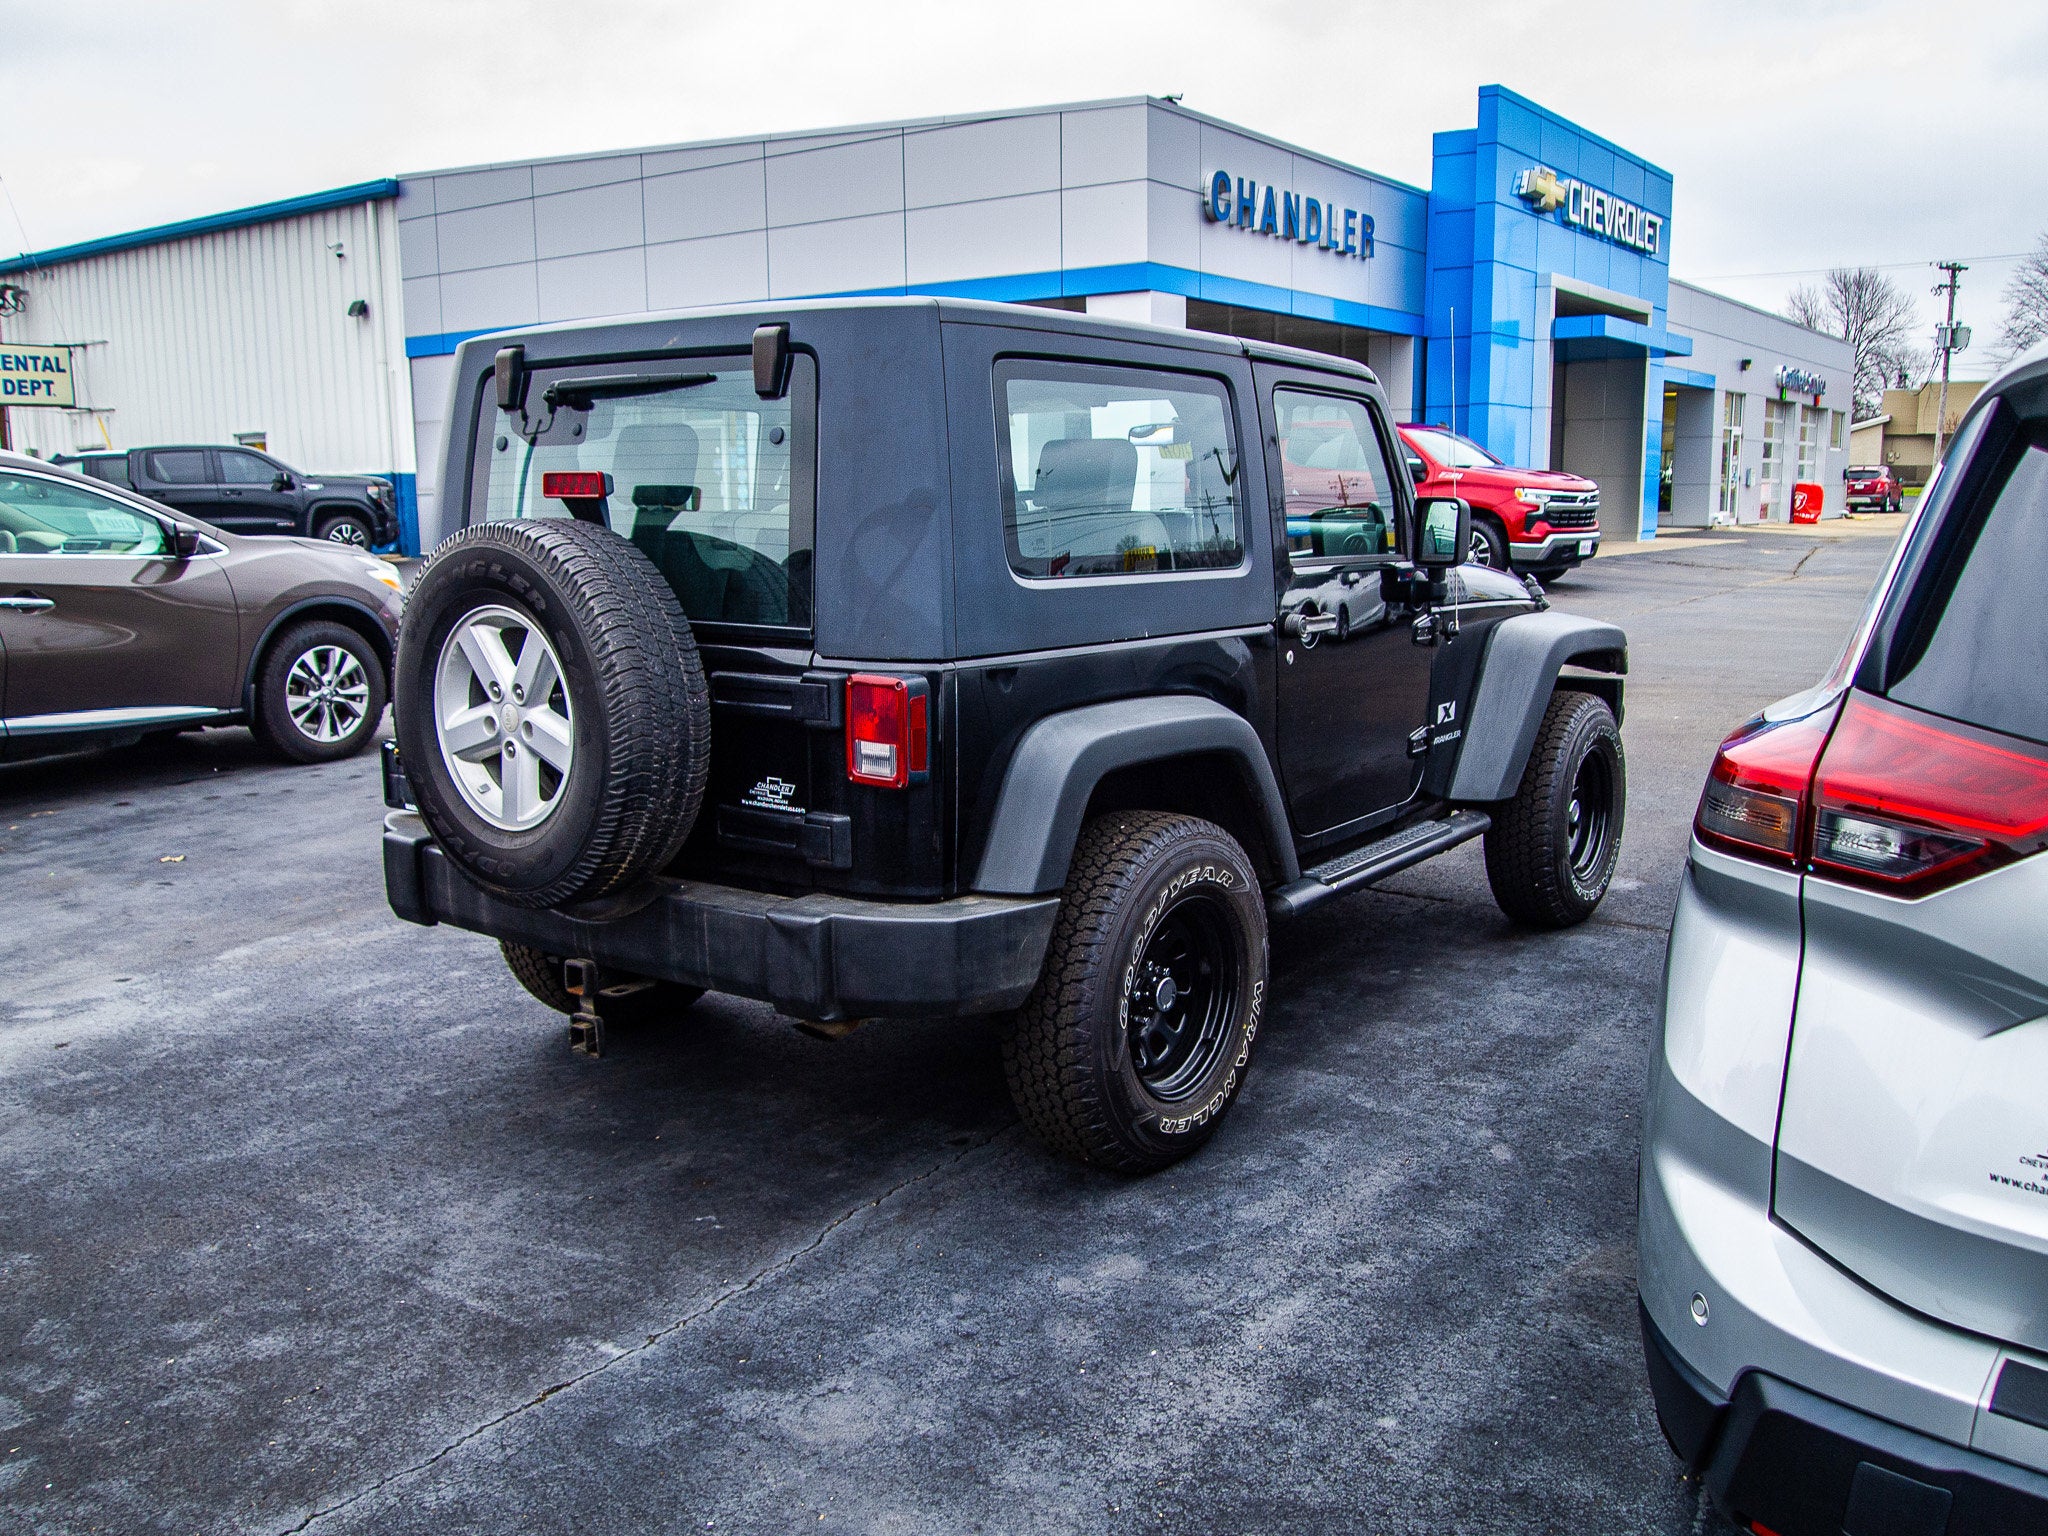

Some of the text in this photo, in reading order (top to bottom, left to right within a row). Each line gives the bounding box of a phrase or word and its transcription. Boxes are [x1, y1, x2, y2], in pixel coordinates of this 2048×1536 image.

[1203, 170, 1375, 259] CHANDLER
[1564, 178, 1663, 254] CHEVROLET
[0, 353, 67, 374] ENTAL
[756, 782, 790, 793] CHANDLER
[1119, 865, 1235, 1030] GOODYEAR
[1159, 980, 1265, 1135] WRANGLER
[1989, 1172, 2048, 1196] www.cha
